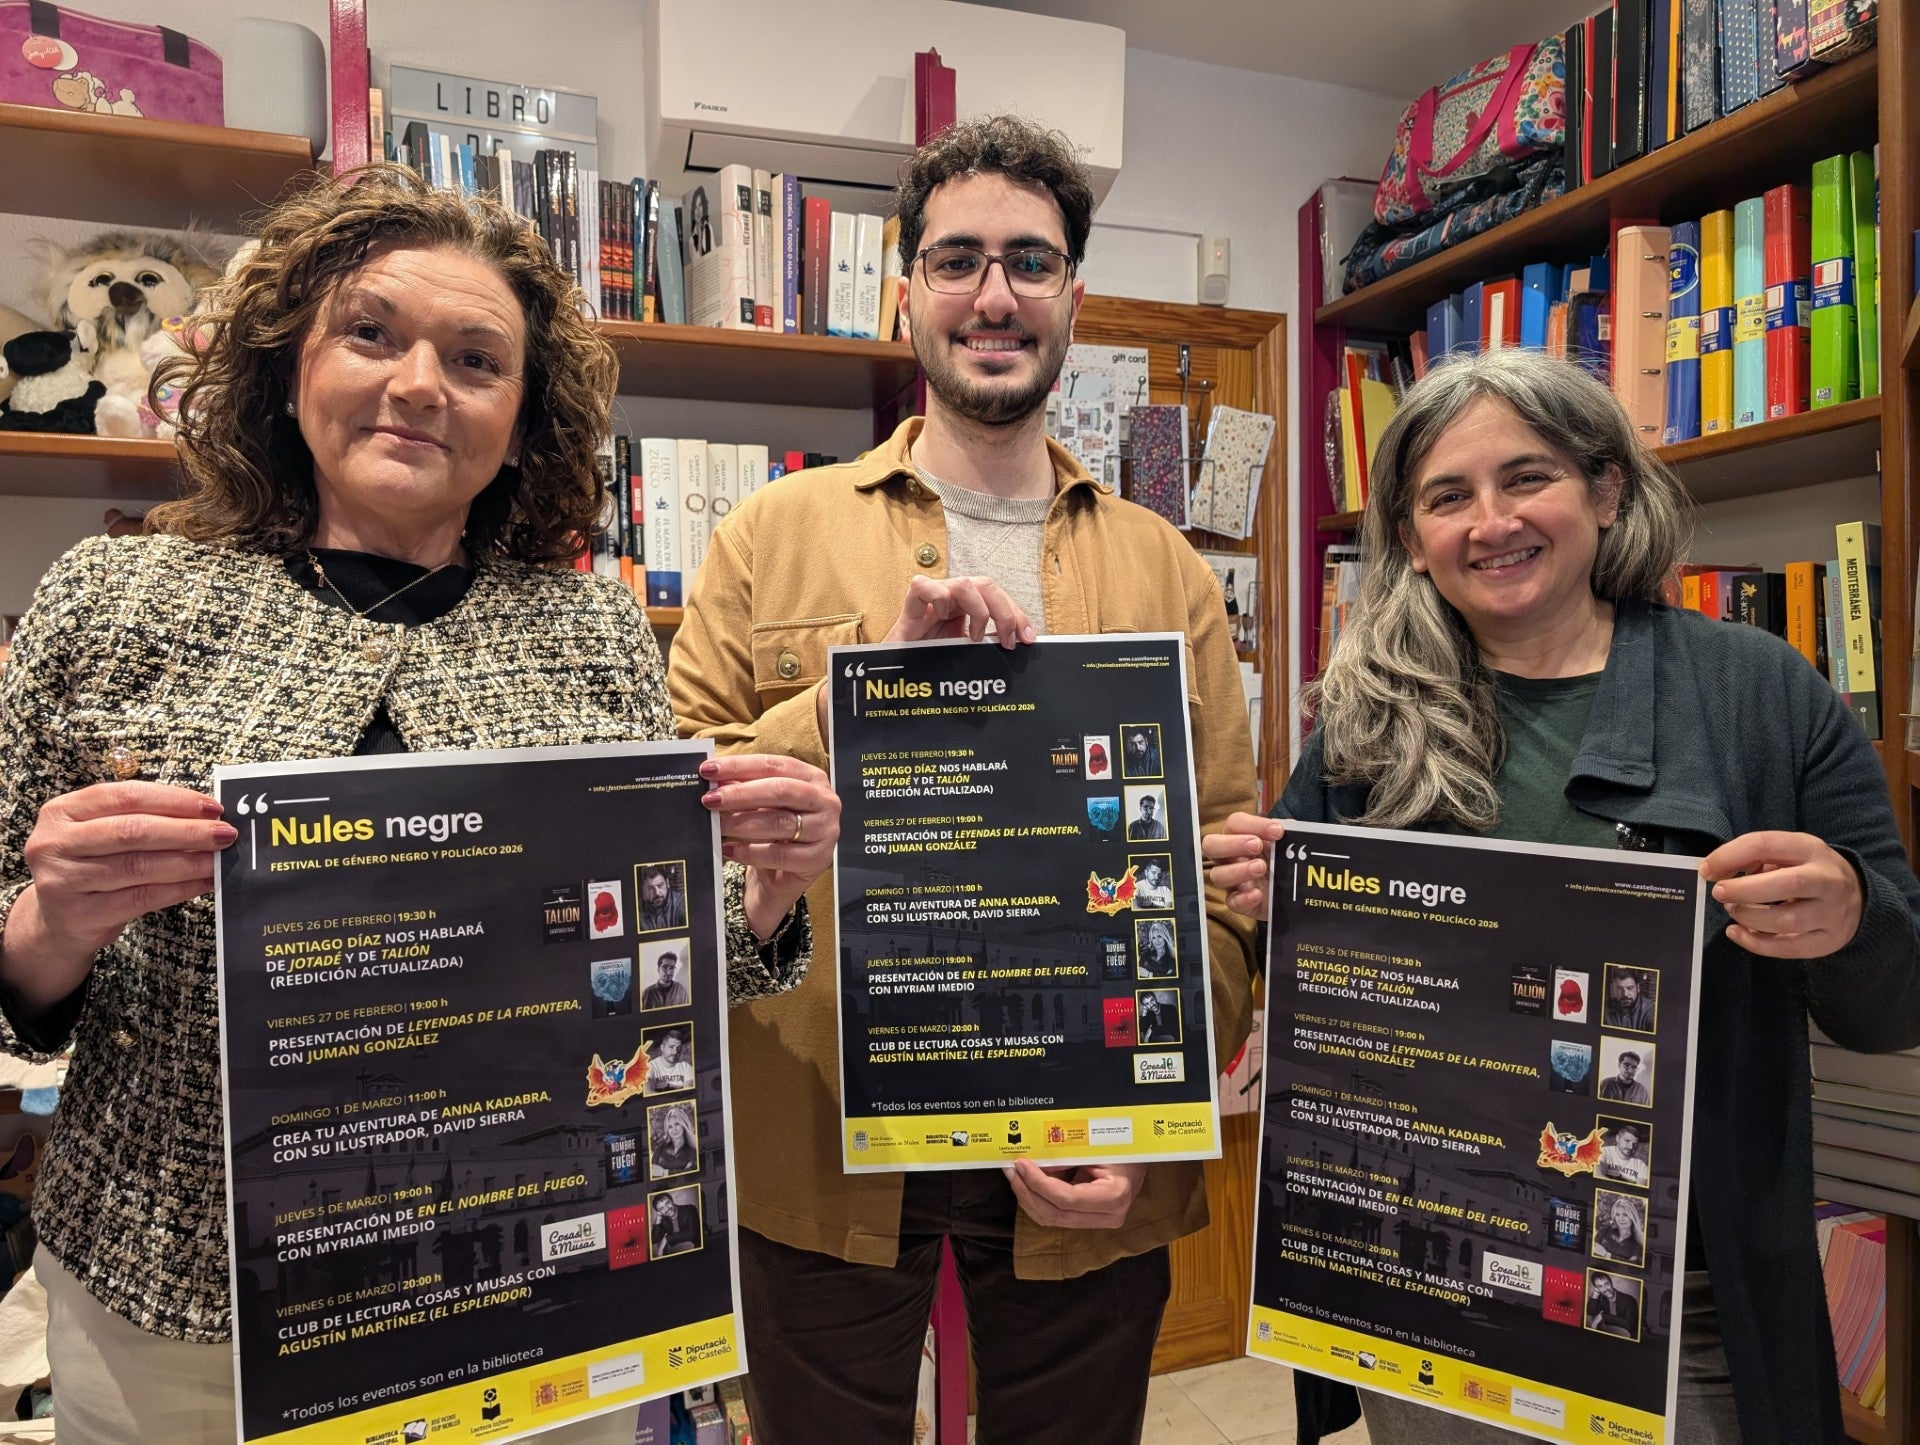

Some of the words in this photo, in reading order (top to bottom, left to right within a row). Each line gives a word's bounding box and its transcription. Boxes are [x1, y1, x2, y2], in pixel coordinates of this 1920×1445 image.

[437, 82, 549, 124] LIBRO
[701, 104, 728, 112] DAIKIN
[787, 182, 793, 192] LA
[1112, 353, 1125, 364] gift
[1128, 355, 1146, 363] card
[649, 449, 660, 489] ZUECO
[1831, 577, 1842, 615] QUERIDAS
[1846, 558, 1862, 622] MEDITERRÁNEA
[1833, 616, 1844, 649] HERIDAS
[866, 678, 932, 700] Nules
[939, 678, 1006, 701] negre
[1051, 751, 1079, 766] TALIÓN
[865, 787, 921, 800] (REEDICIÓN
[923, 784, 994, 796] ACTUALIZADA)
[271, 814, 374, 847] Nules
[386, 812, 483, 842] negre
[270, 859, 322, 872] FESTIVAL
[324, 858, 339, 867] DE
[342, 854, 388, 866] GÉNERO
[390, 851, 429, 862] NEGRO
[431, 851, 438, 859] Y
[441, 845, 498, 859] POLICÍACO
[499, 844, 523, 854] 2026
[865, 845, 886, 854] CON
[889, 843, 923, 854] JUMAN
[925, 840, 977, 851] GONZÁLEZ
[1307, 865, 1381, 895] Nules
[1389, 879, 1466, 907] negre
[1614, 881, 1685, 894] www.castellonegre.es
[544, 906, 580, 924] TALIÓN
[866, 914, 889, 924] CON
[891, 913, 904, 923] SU
[906, 910, 971, 922] ILUSTRADOR,
[973, 909, 1004, 919] DAVID
[1006, 908, 1040, 918] SIERRA
[265, 938, 343, 957] SANTIAGO
[347, 934, 381, 948] DÍAZ
[385, 931, 416, 944] NOS
[419, 922, 484, 941] HABLARÁ
[270, 968, 356, 990] (REEDICIÓN
[360, 956, 463, 977] ACTUALIZADA)
[1298, 982, 1358, 999] (REEDICIÓN
[1360, 991, 1440, 1013] ACTUALIZADA)
[1512, 982, 1546, 1000] TALIÓN
[269, 1052, 303, 1067] CON
[308, 1044, 360, 1064] JUMAN
[364, 1033, 439, 1053] GONZÁLEZ
[869, 1051, 914, 1063] AGUSTÍN
[916, 1050, 968, 1061] MARTÍNEZ
[970, 1050, 984, 1061] (EL
[987, 1047, 1046, 1059] ESPLENDOR)
[1293, 1039, 1316, 1051] CON
[1317, 1043, 1356, 1058] JUMAN
[1358, 1050, 1415, 1068] GONZÁLEZ
[1140, 1061, 1165, 1071] Cosas
[1167, 1119, 1203, 1129] Diputació
[273, 1147, 307, 1163] CON
[311, 1143, 330, 1157] SU
[335, 1127, 429, 1152] ILUSTRADOR,
[433, 1117, 476, 1135] DAVID
[479, 1109, 525, 1127] SIERRA
[611, 1153, 637, 1170] FUEGO
[1286, 1182, 1309, 1195] CON
[1312, 1188, 1355, 1206] MYRIAM
[1358, 1198, 1398, 1215] IMEDIO
[277, 1213, 391, 1247] PRESENTACIÓN
[395, 1208, 414, 1222] DE
[417, 1203, 436, 1218] EN
[439, 1200, 454, 1213] EL
[458, 1188, 514, 1210] NOMBRE
[517, 1183, 540, 1197] DEL
[543, 1174, 588, 1192] FUEGO,
[550, 1231, 580, 1244] Cosas
[1280, 1250, 1326, 1268] AGUSTÍN
[1329, 1261, 1384, 1283] MARTÍNEZ
[1386, 1276, 1401, 1288] (EL
[1404, 1280, 1471, 1307] ESPLENDOR)
[1490, 1261, 1518, 1276] Cosas
[278, 1329, 346, 1356] AGUSTÍN
[351, 1310, 426, 1339] MARTÍNEZ
[429, 1305, 449, 1322] (EL
[453, 1286, 532, 1314] ESPLENDOR)
[686, 1336, 727, 1354] Diputació
[686, 1355, 697, 1364] de
[698, 1345, 732, 1360] Castelló
[338, 1395, 358, 1408] los
[362, 1380, 416, 1402] eventos
[419, 1373, 444, 1387] son
[447, 1368, 464, 1380] en
[467, 1363, 479, 1374] la
[482, 1347, 544, 1370] biblioteca
[1608, 1421, 1653, 1439] Diputació
